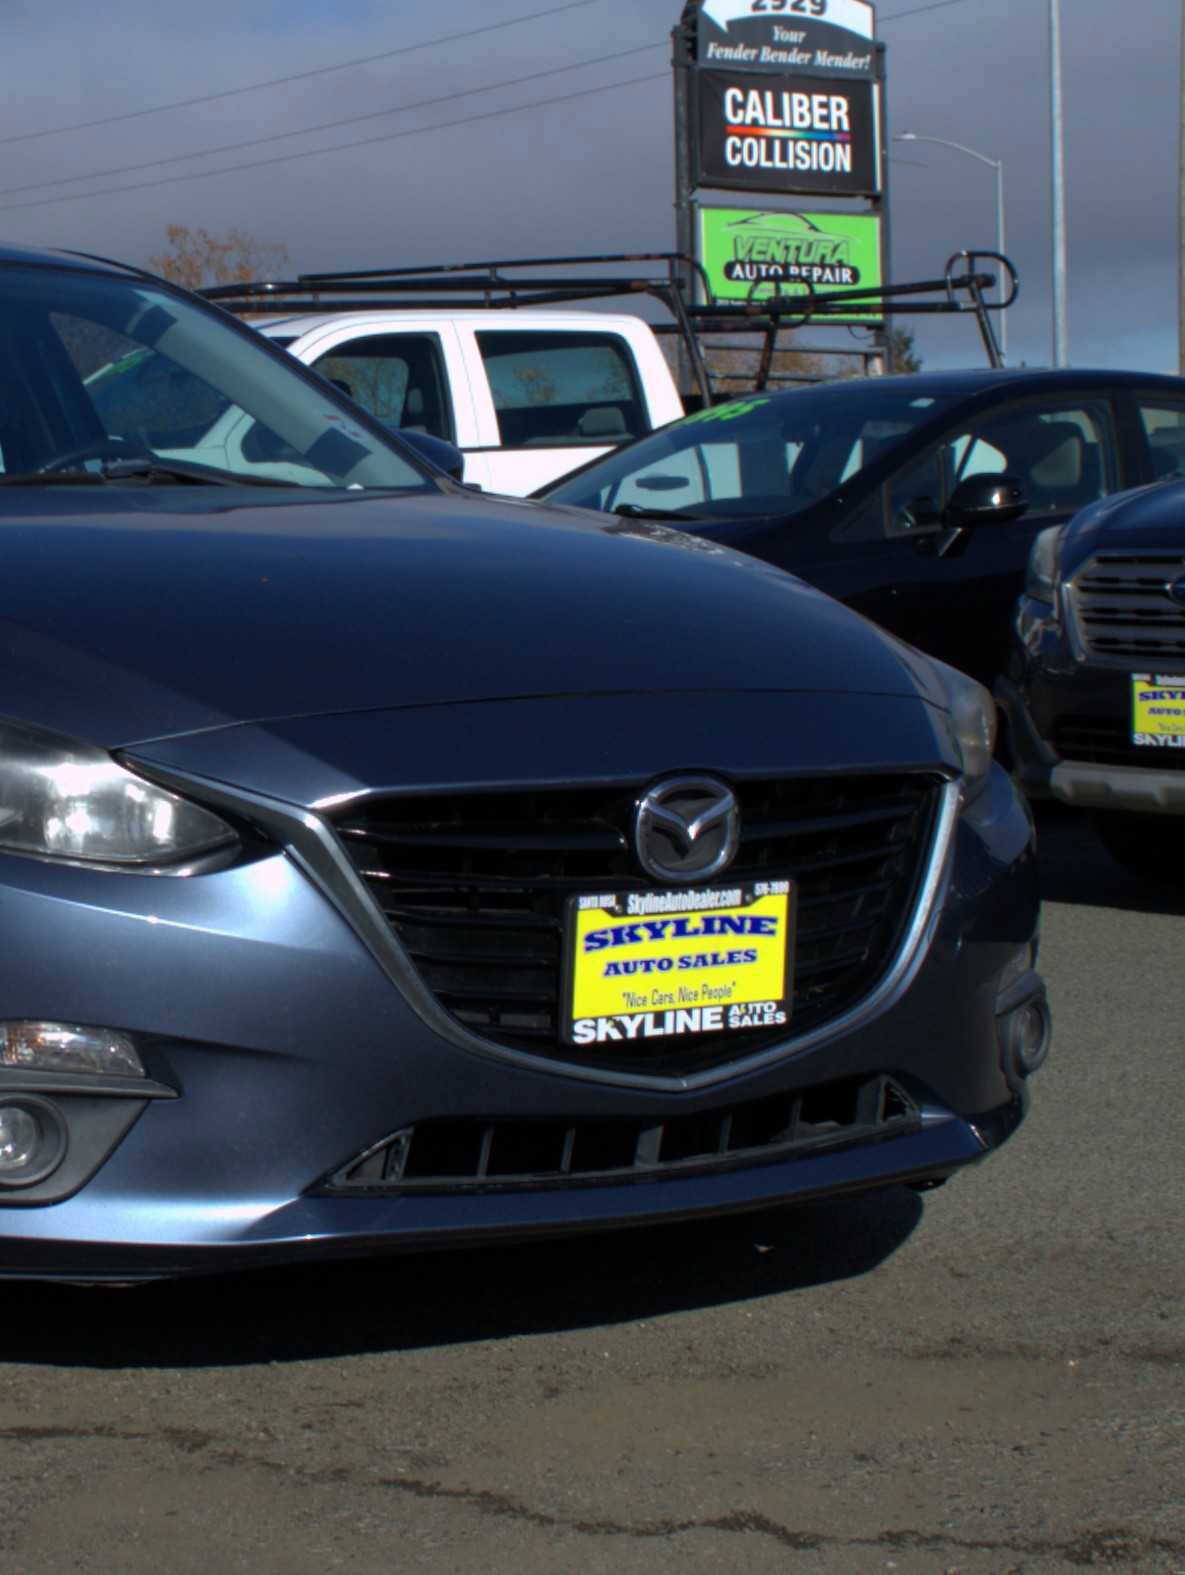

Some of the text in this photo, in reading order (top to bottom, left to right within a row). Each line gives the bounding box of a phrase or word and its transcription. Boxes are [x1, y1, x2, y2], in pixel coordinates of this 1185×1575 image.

[772, 25, 807, 43] Your
[706, 42, 871, 70] Fender Bender Mender!
[724, 87, 850, 131] CALIBER
[725, 136, 852, 172] COLLISION
[733, 235, 850, 264] VENTURA
[731, 263, 854, 283] AUTO REPAIR
[1139, 691, 1185, 701] SKY
[583, 914, 779, 952] SKYLINE
[603, 949, 757, 977] AUTO SALES
[678, 987, 699, 1004] Nice
[728, 1001, 776, 1016] AUTO
[573, 1006, 723, 1044] SKYLINE
[728, 1011, 787, 1028] SALES
